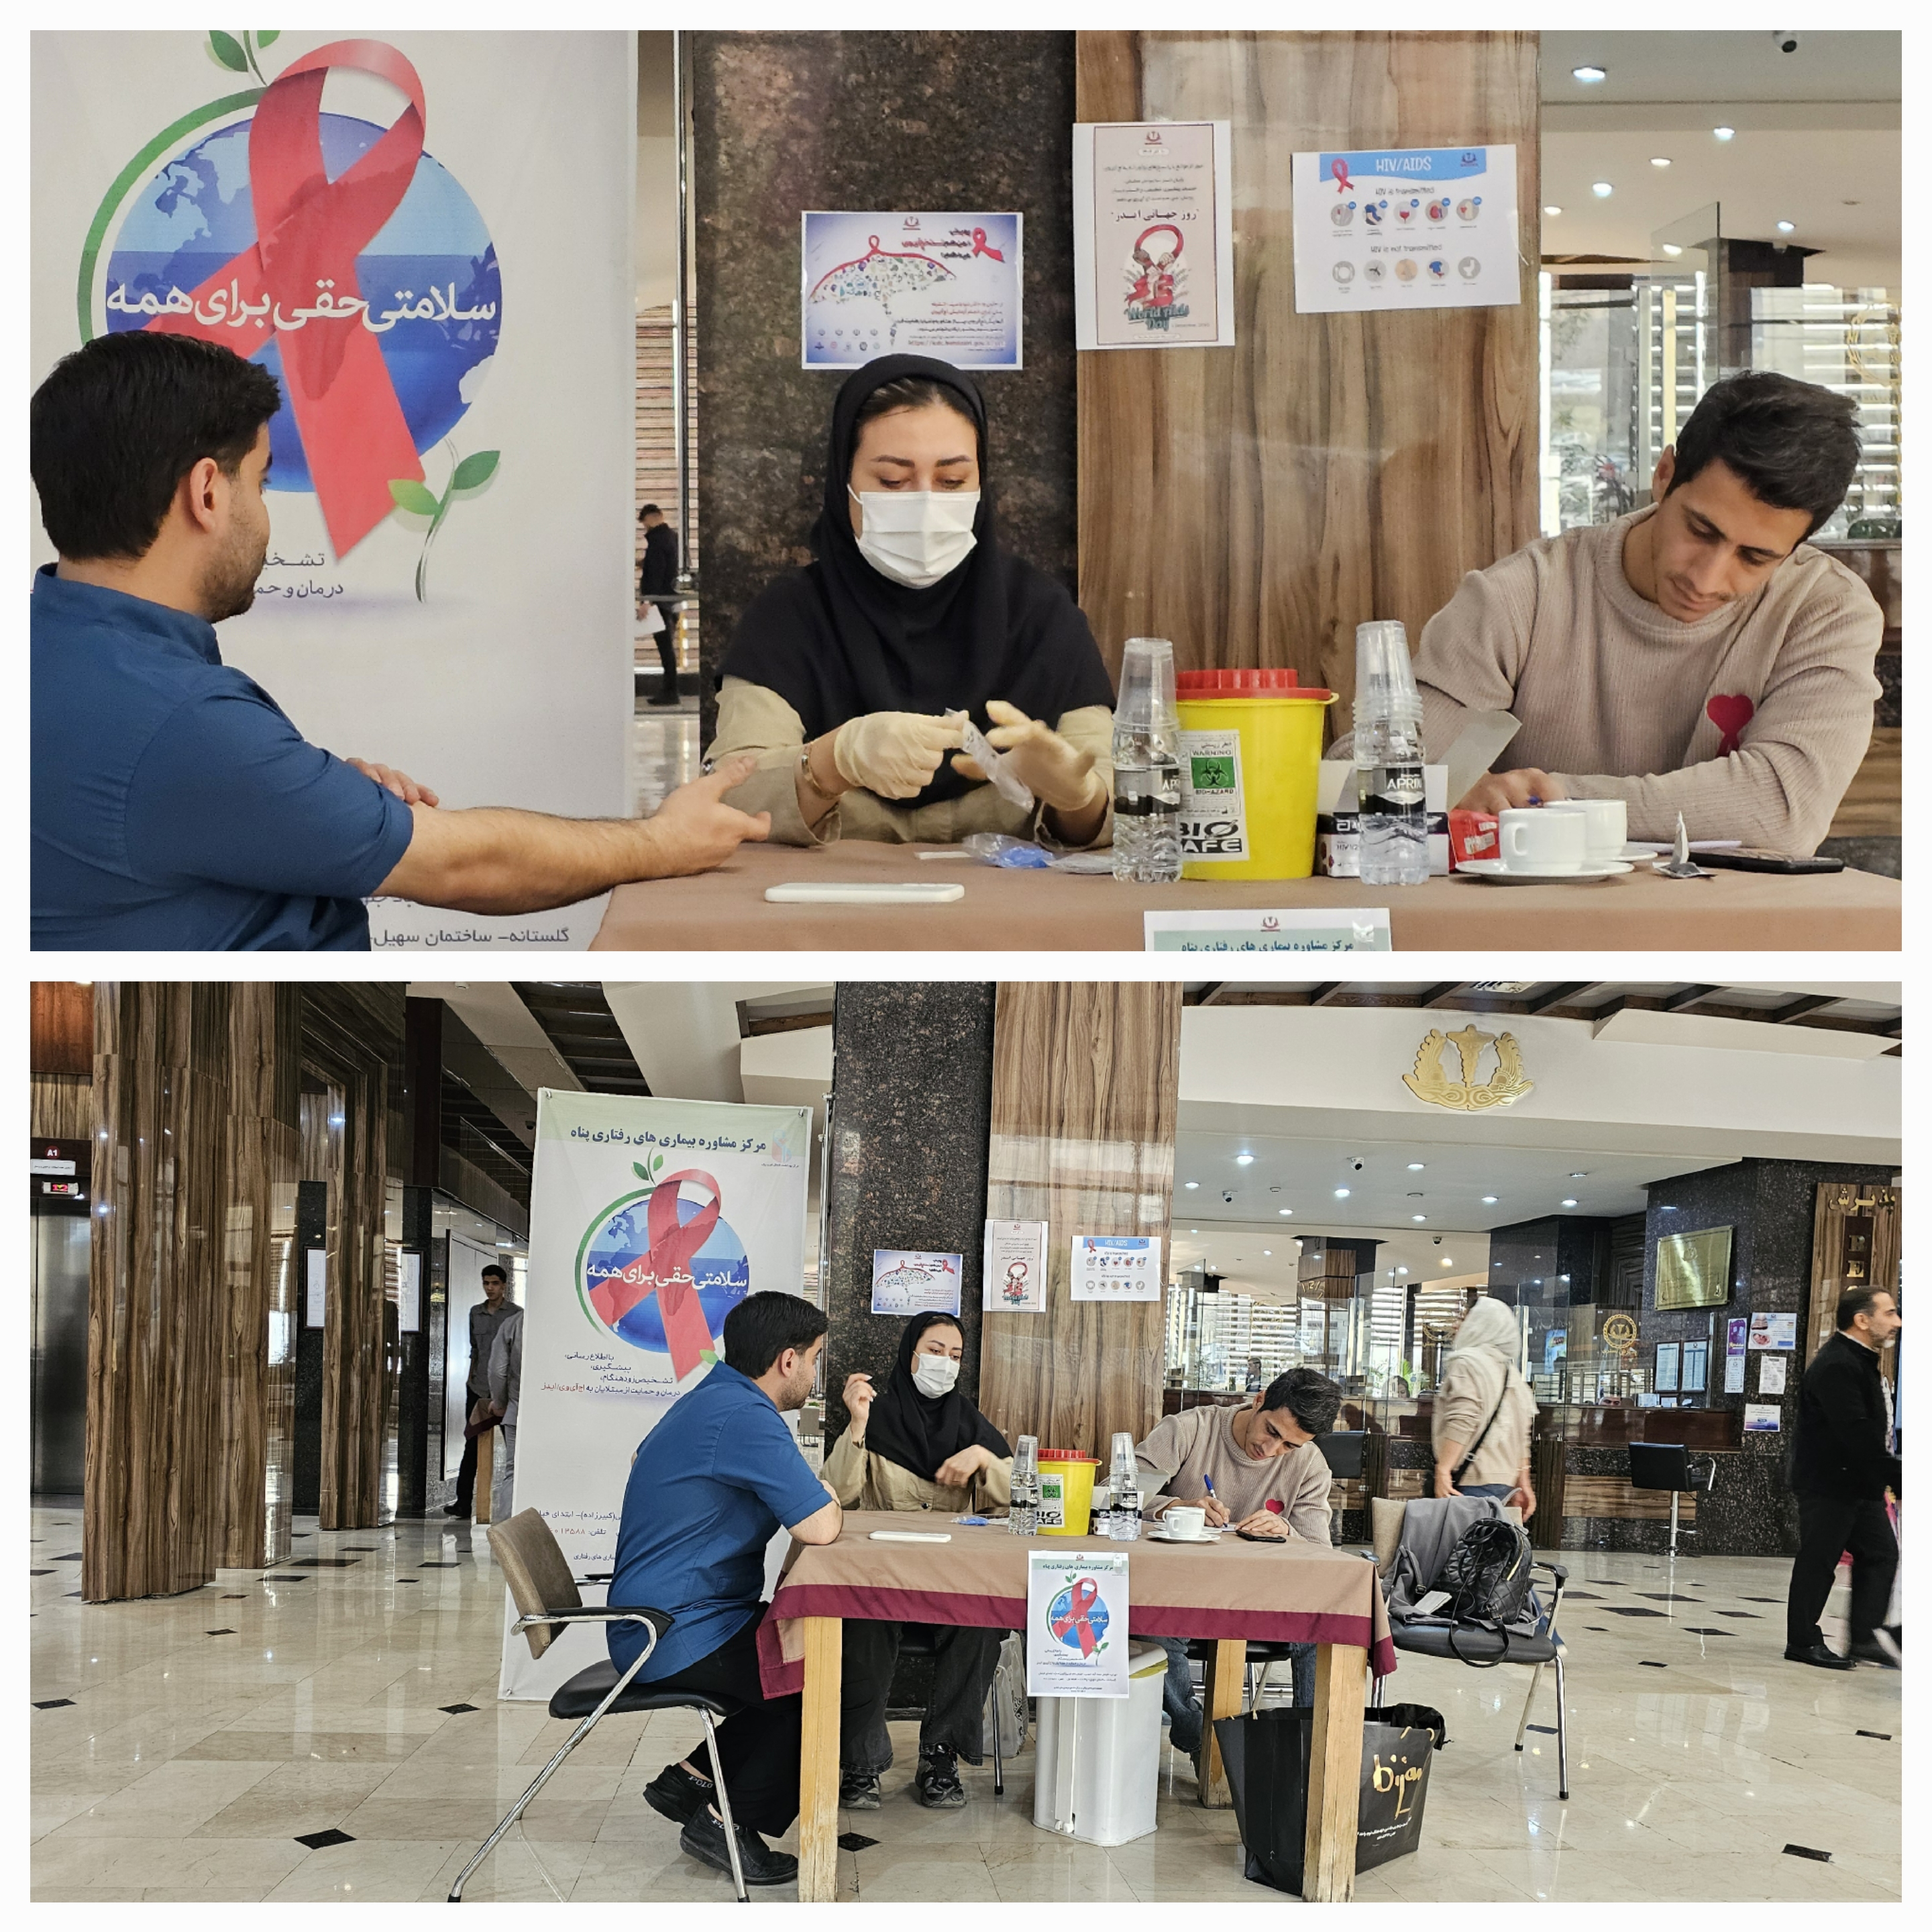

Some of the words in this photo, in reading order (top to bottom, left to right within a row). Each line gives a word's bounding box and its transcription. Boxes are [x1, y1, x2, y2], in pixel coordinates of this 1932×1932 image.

[1376, 156, 1432, 172] HIV/AIDS
[107, 282, 195, 315] همه
[195, 278, 271, 331] برای
[274, 278, 368, 329] حقی
[363, 282, 496, 333] سلامتی
[264, 552, 325, 570] تشخی
[282, 586, 294, 598] و
[297, 580, 343, 598] درمان
[1180, 820, 1239, 838] BIO
[1181, 839, 1241, 853] AFE
[425, 928, 492, 947] ساختمان
[570, 1126, 590, 1142] پناه
[592, 1129, 631, 1144] رفتاری
[633, 1131, 656, 1145] های
[659, 1133, 696, 1148] بیماری
[698, 1136, 737, 1151] مشاوره
[739, 1138, 767, 1153] مرکز
[1828, 1187, 1896, 1215] پذیرش
[586, 1264, 623, 1278] همه
[623, 1265, 654, 1285] برای
[655, 1267, 694, 1287] حقی
[692, 1271, 747, 1290] سلامتی
[636, 1376, 673, 1385] تشخیص
[594, 1385, 625, 1394] مبتلایان
[631, 1387, 655, 1395] حمایت
[661, 1388, 681, 1397] درمان
[552, 1510, 574, 1519] ابتدای
[1063, 1615, 1075, 1623] برای
[1075, 1615, 1088, 1623] حقی
[1087, 1616, 1108, 1624] سلامتی
[1373, 1754, 1422, 1820] bijan
